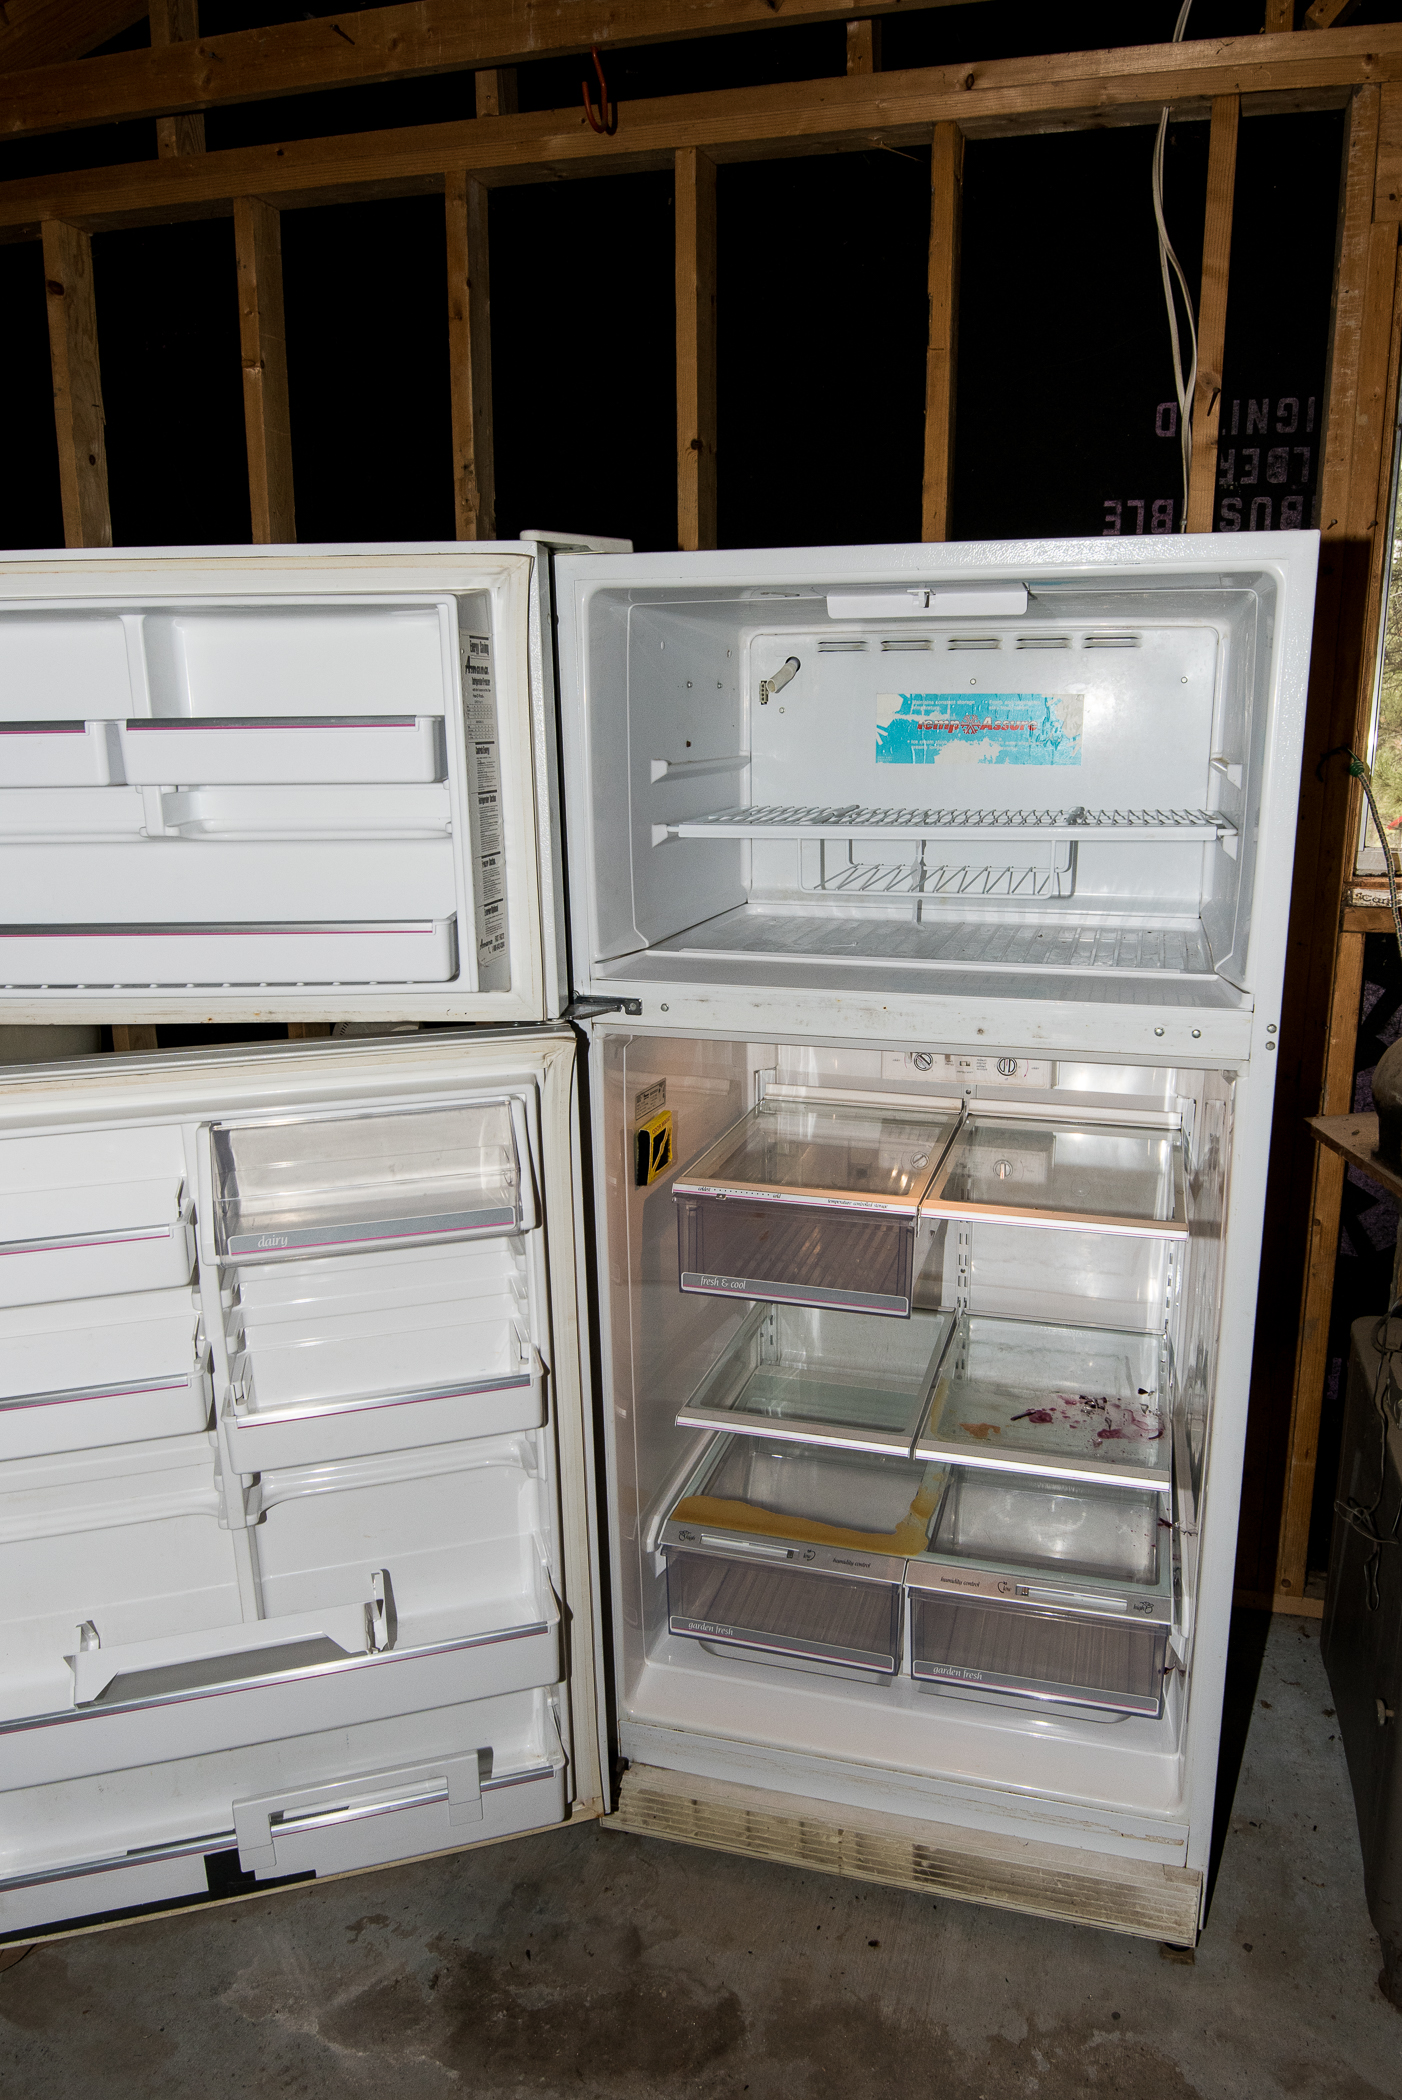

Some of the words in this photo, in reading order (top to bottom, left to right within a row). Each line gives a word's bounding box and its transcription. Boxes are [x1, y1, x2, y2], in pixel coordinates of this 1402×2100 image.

[1155, 396, 1316, 438] IGNID
[465, 656, 490, 674] Amana
[980, 716, 1038, 732] Assure
[257, 1234, 288, 1248] dairy
[700, 1276, 719, 1288] fresh
[721, 1278, 729, 1288] &
[730, 1280, 746, 1290] cool
[833, 1557, 854, 1566] humidity
[940, 1576, 962, 1585] humidity
[688, 1620, 714, 1633] garden
[715, 1625, 734, 1636] fresh
[933, 1665, 961, 1678] garden
[962, 1669, 983, 1681] fresh
